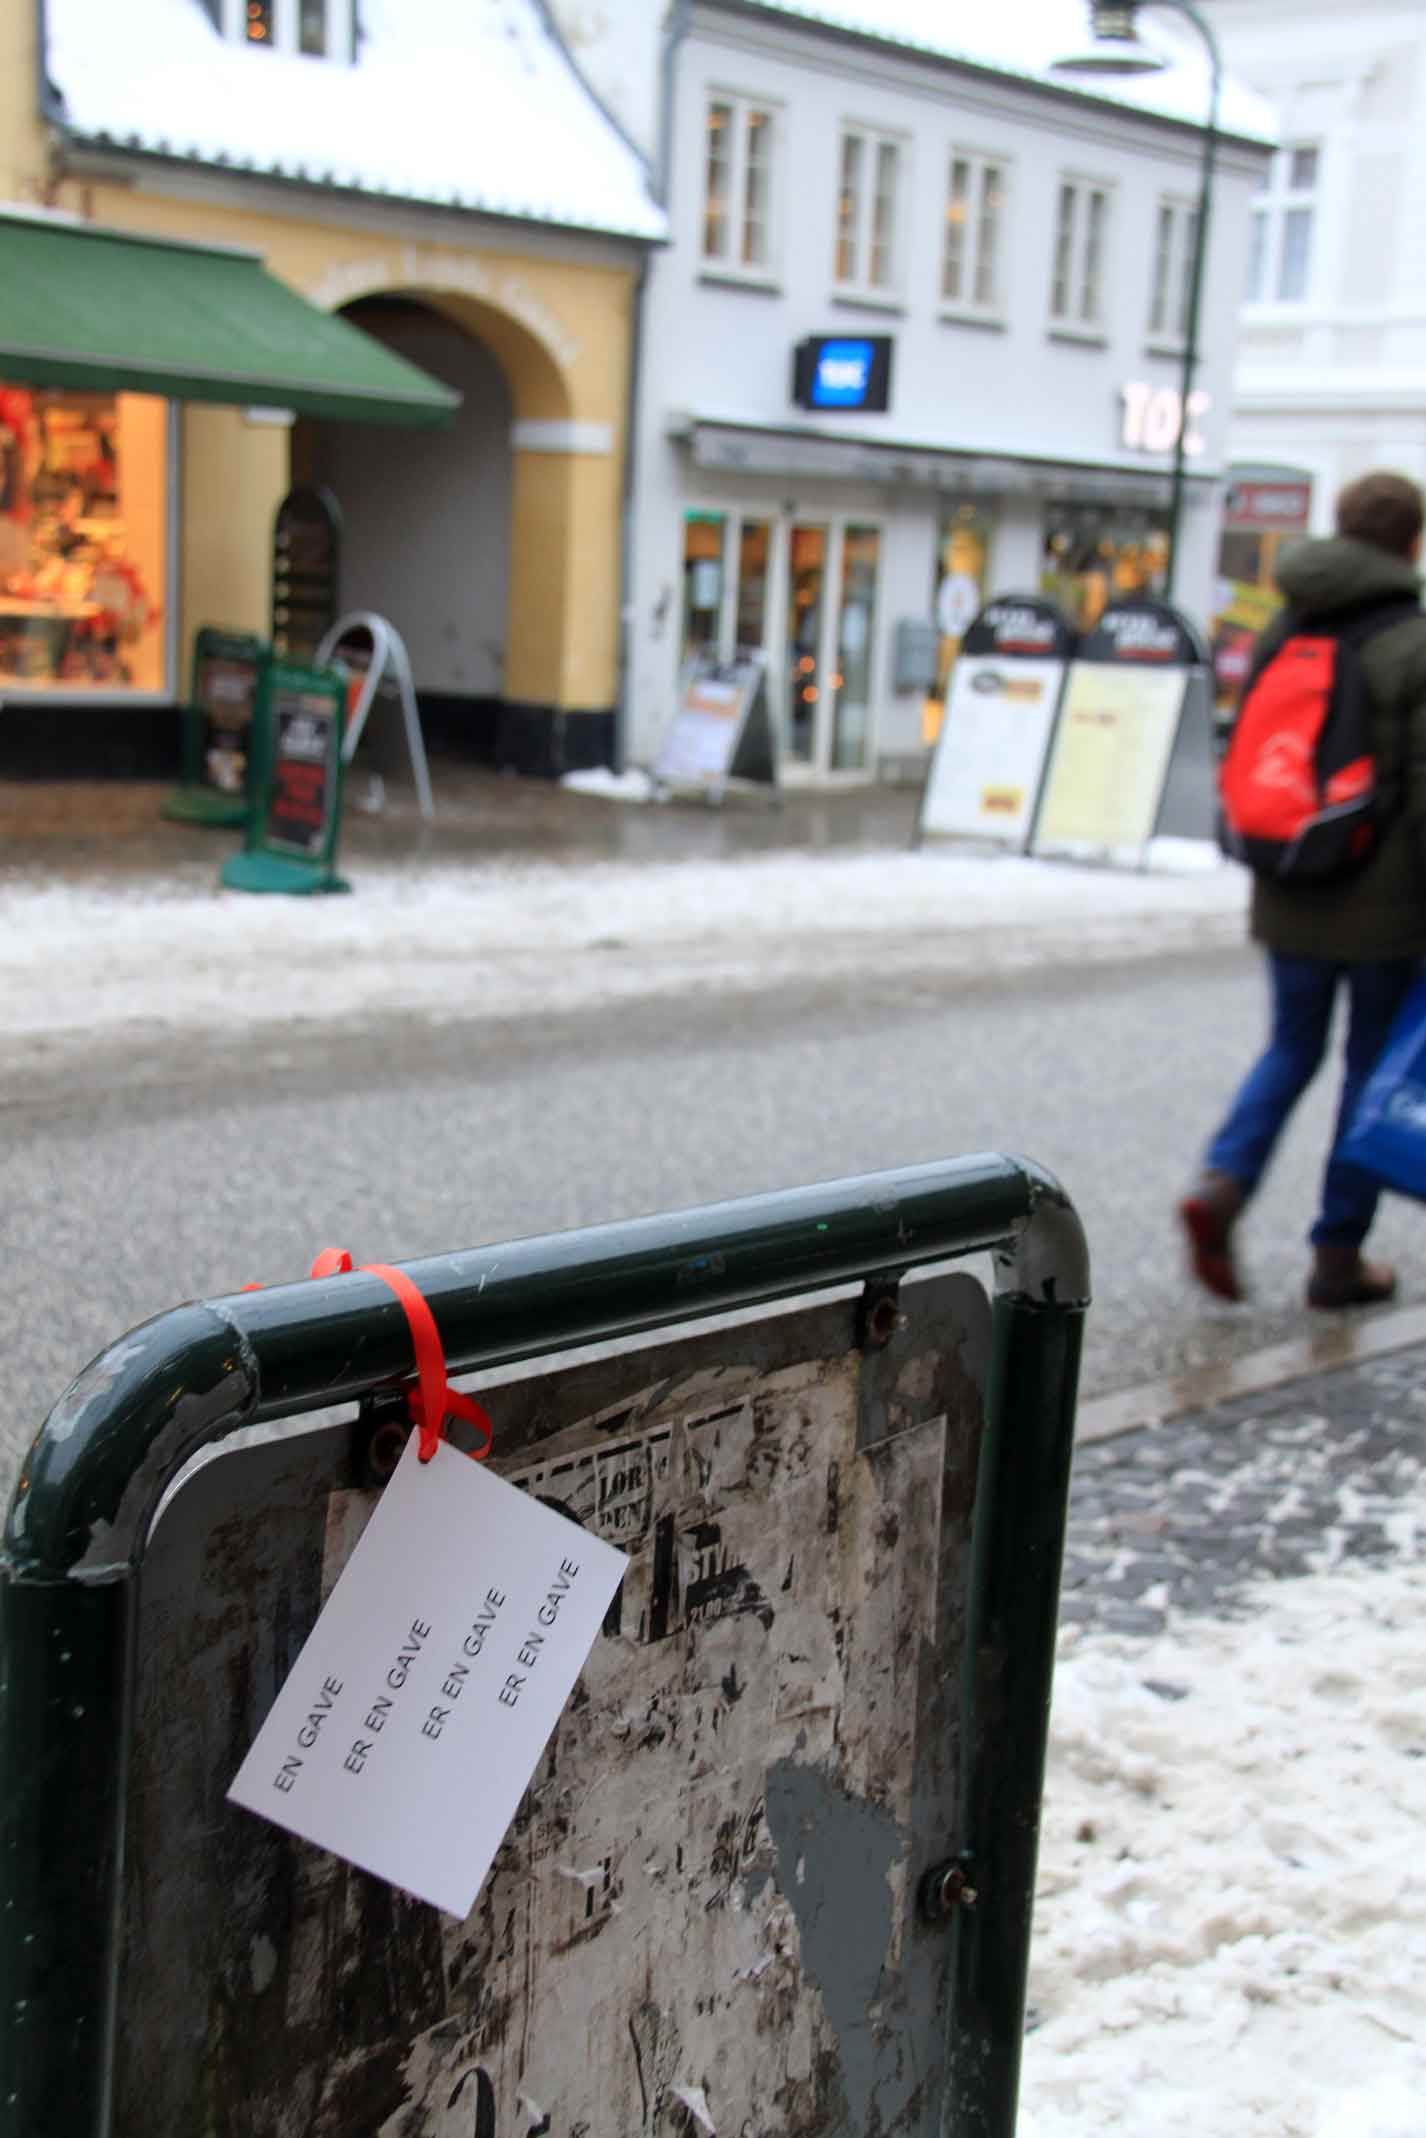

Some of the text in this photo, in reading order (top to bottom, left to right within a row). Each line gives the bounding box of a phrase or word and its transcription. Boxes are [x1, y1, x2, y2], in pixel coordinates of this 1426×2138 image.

[344, 1619, 431, 1774] ER EN GAVE
[422, 1588, 506, 1740] ER EN GAVE
[499, 1558, 579, 1707] ER EN GAVE
[273, 1677, 343, 1792] EN GAVE
